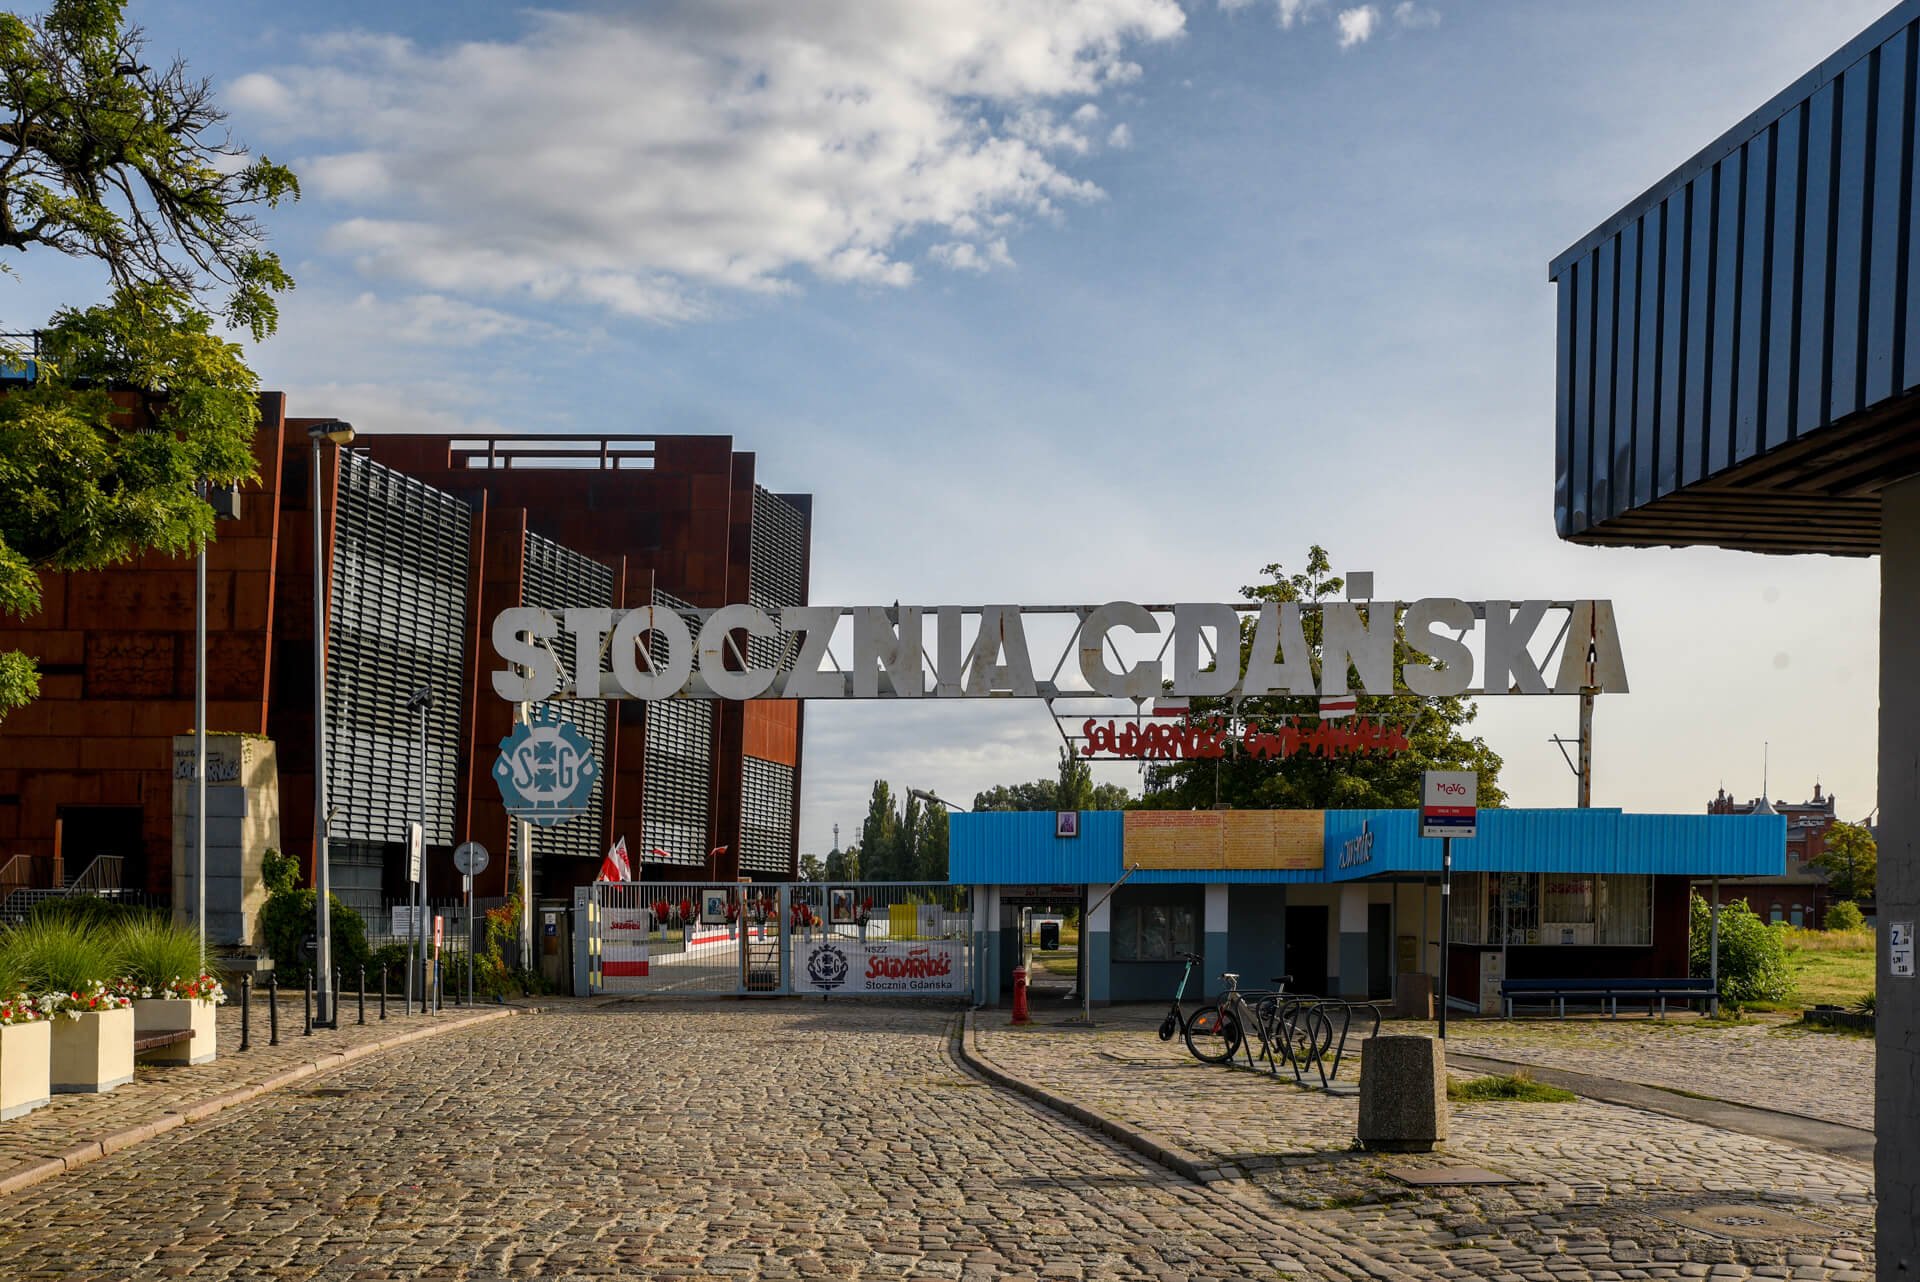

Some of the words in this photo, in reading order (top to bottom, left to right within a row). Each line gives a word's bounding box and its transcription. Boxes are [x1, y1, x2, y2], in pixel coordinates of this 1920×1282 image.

[491, 603, 1039, 702] STOCZNIA
[1079, 571, 1629, 698] GDAŃSKA
[864, 945, 888, 953] NSZZ
[865, 980, 907, 990] Stocznia
